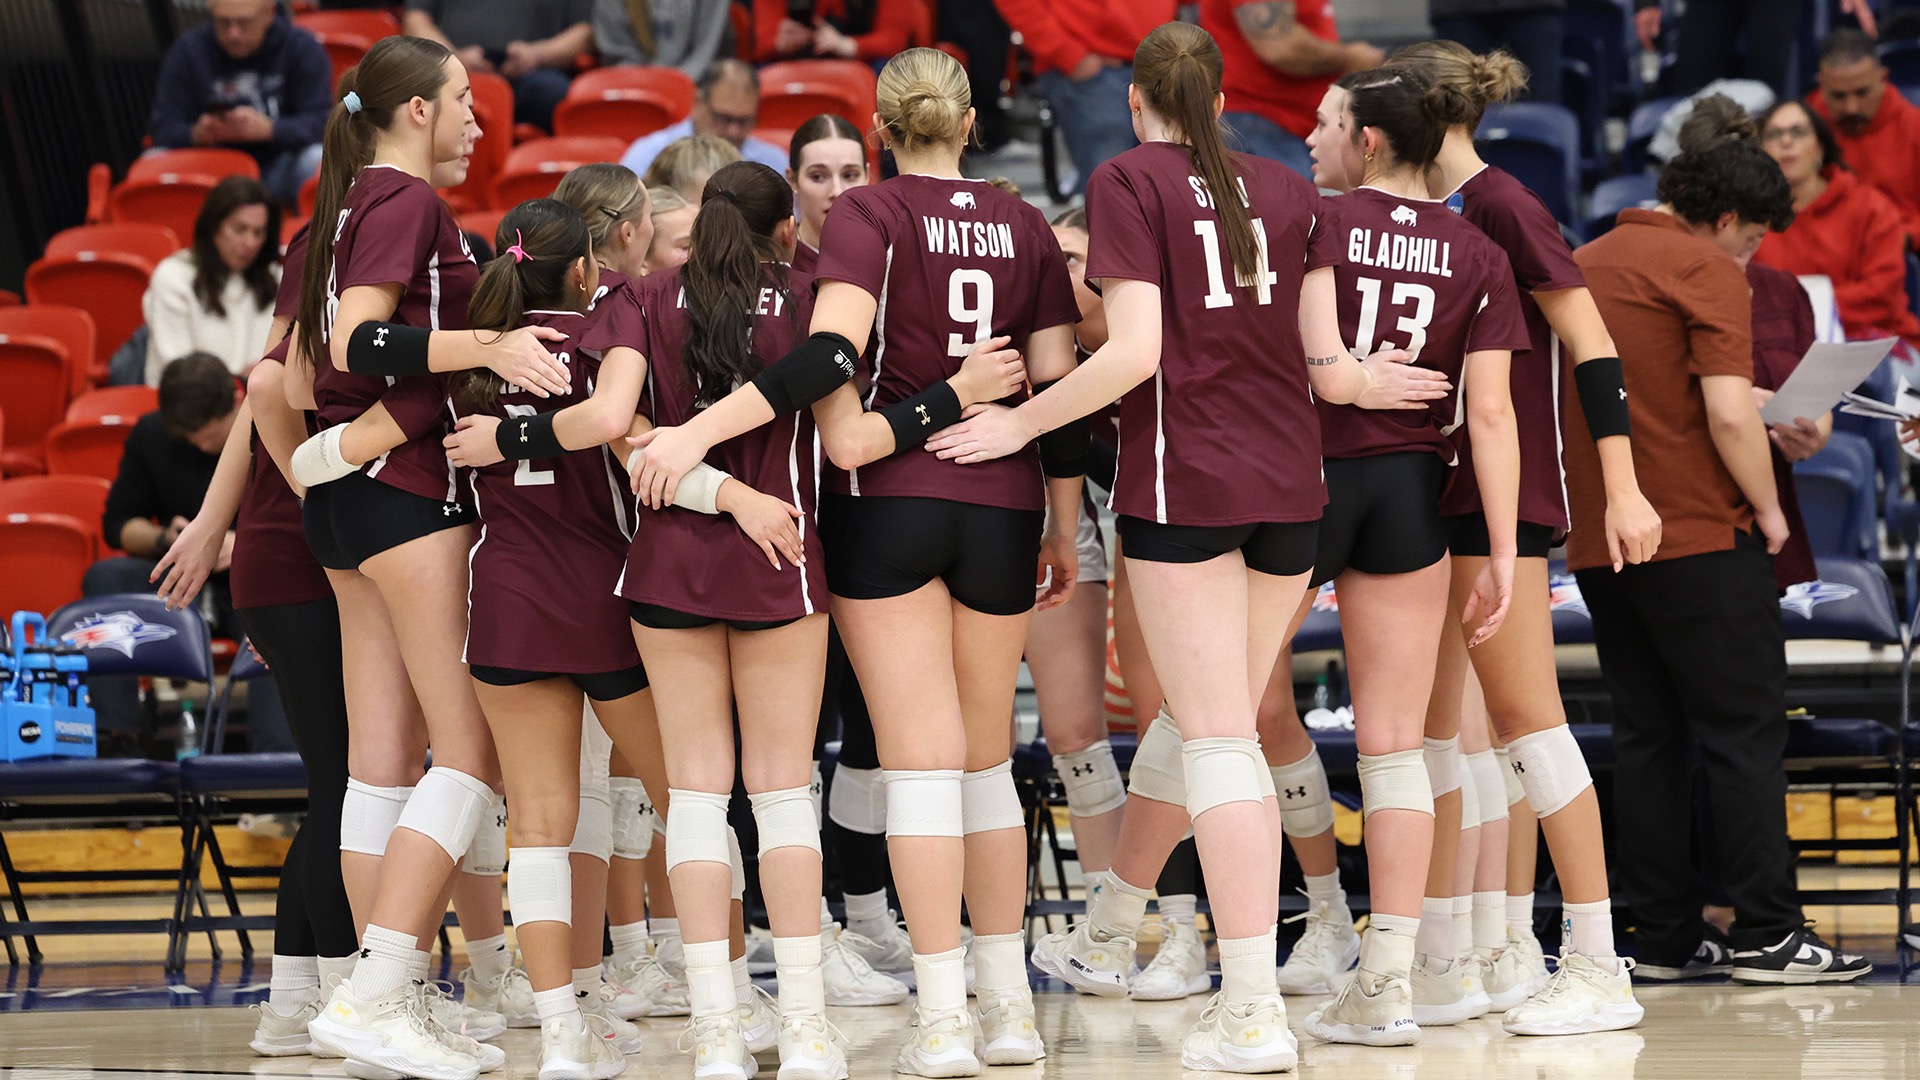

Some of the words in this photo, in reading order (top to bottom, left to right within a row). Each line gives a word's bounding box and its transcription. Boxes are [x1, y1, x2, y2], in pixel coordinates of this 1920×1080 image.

[922, 215, 1015, 259] WATSON
[1347, 227, 1453, 278] GLADHILL
[947, 268, 994, 358] 9
[1349, 276, 1436, 364] 13
